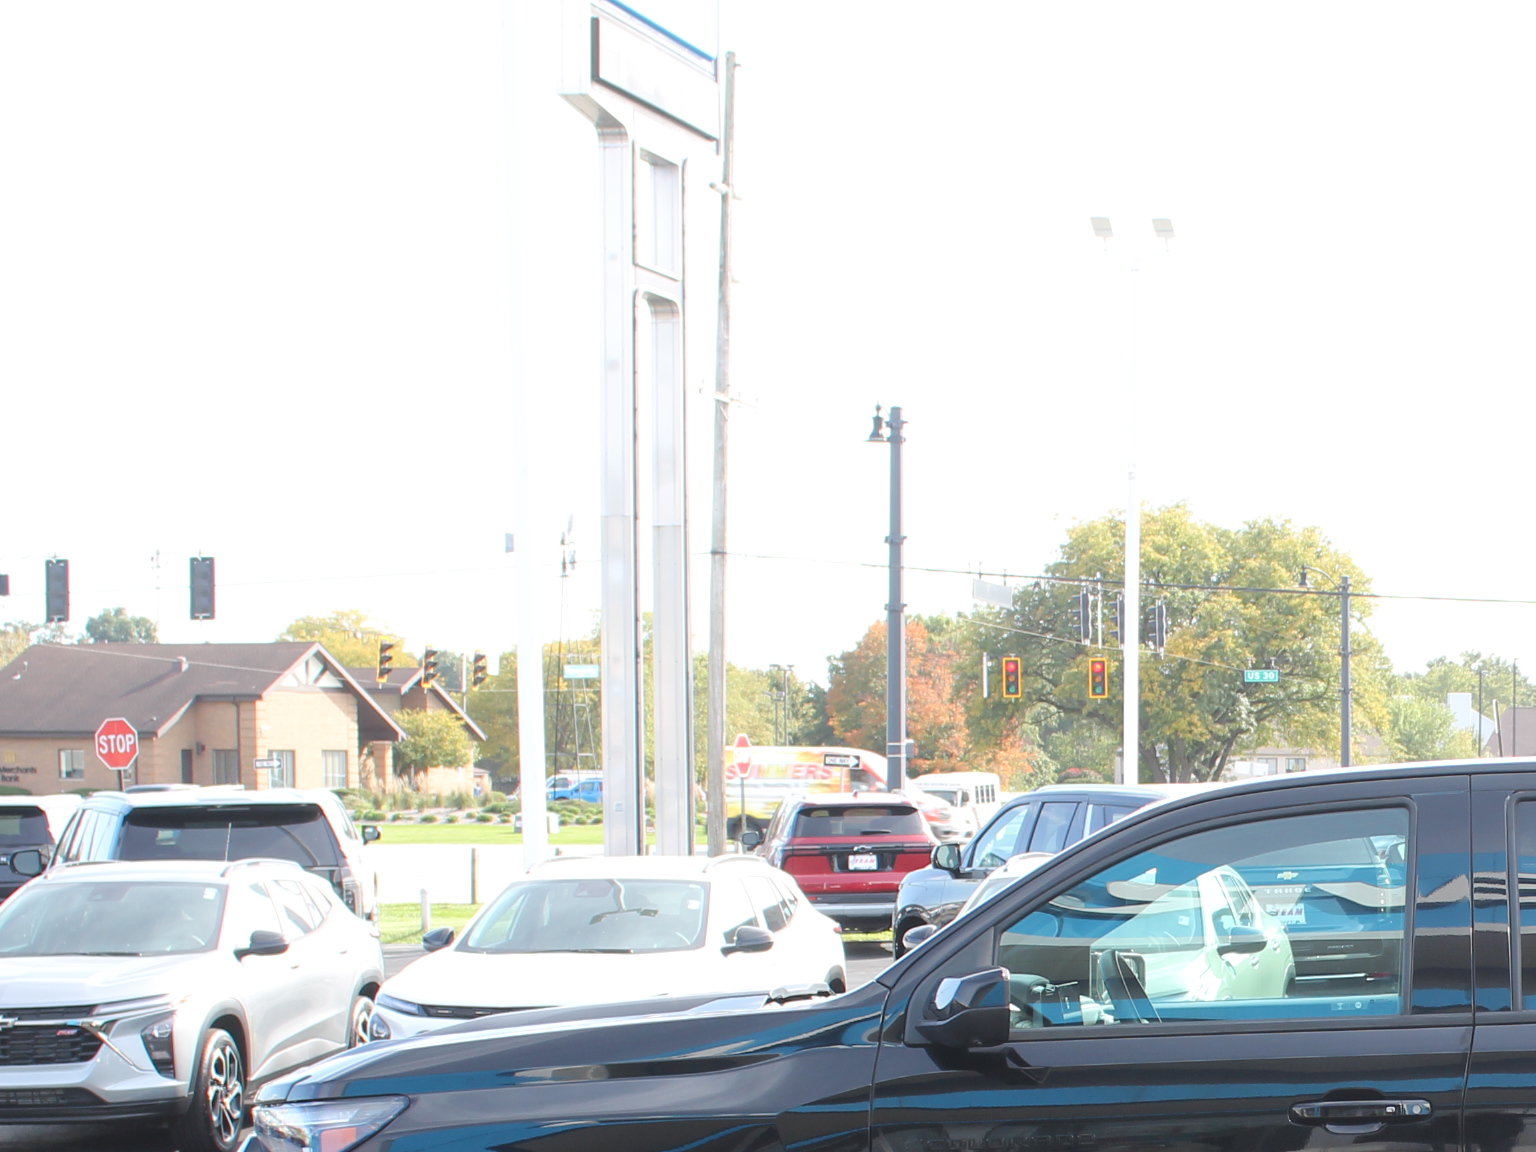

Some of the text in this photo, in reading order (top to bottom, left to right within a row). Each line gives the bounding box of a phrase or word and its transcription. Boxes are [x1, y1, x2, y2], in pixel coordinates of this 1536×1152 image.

[1247, 671, 1275, 680] US 30
[99, 734, 135, 754] STOP
